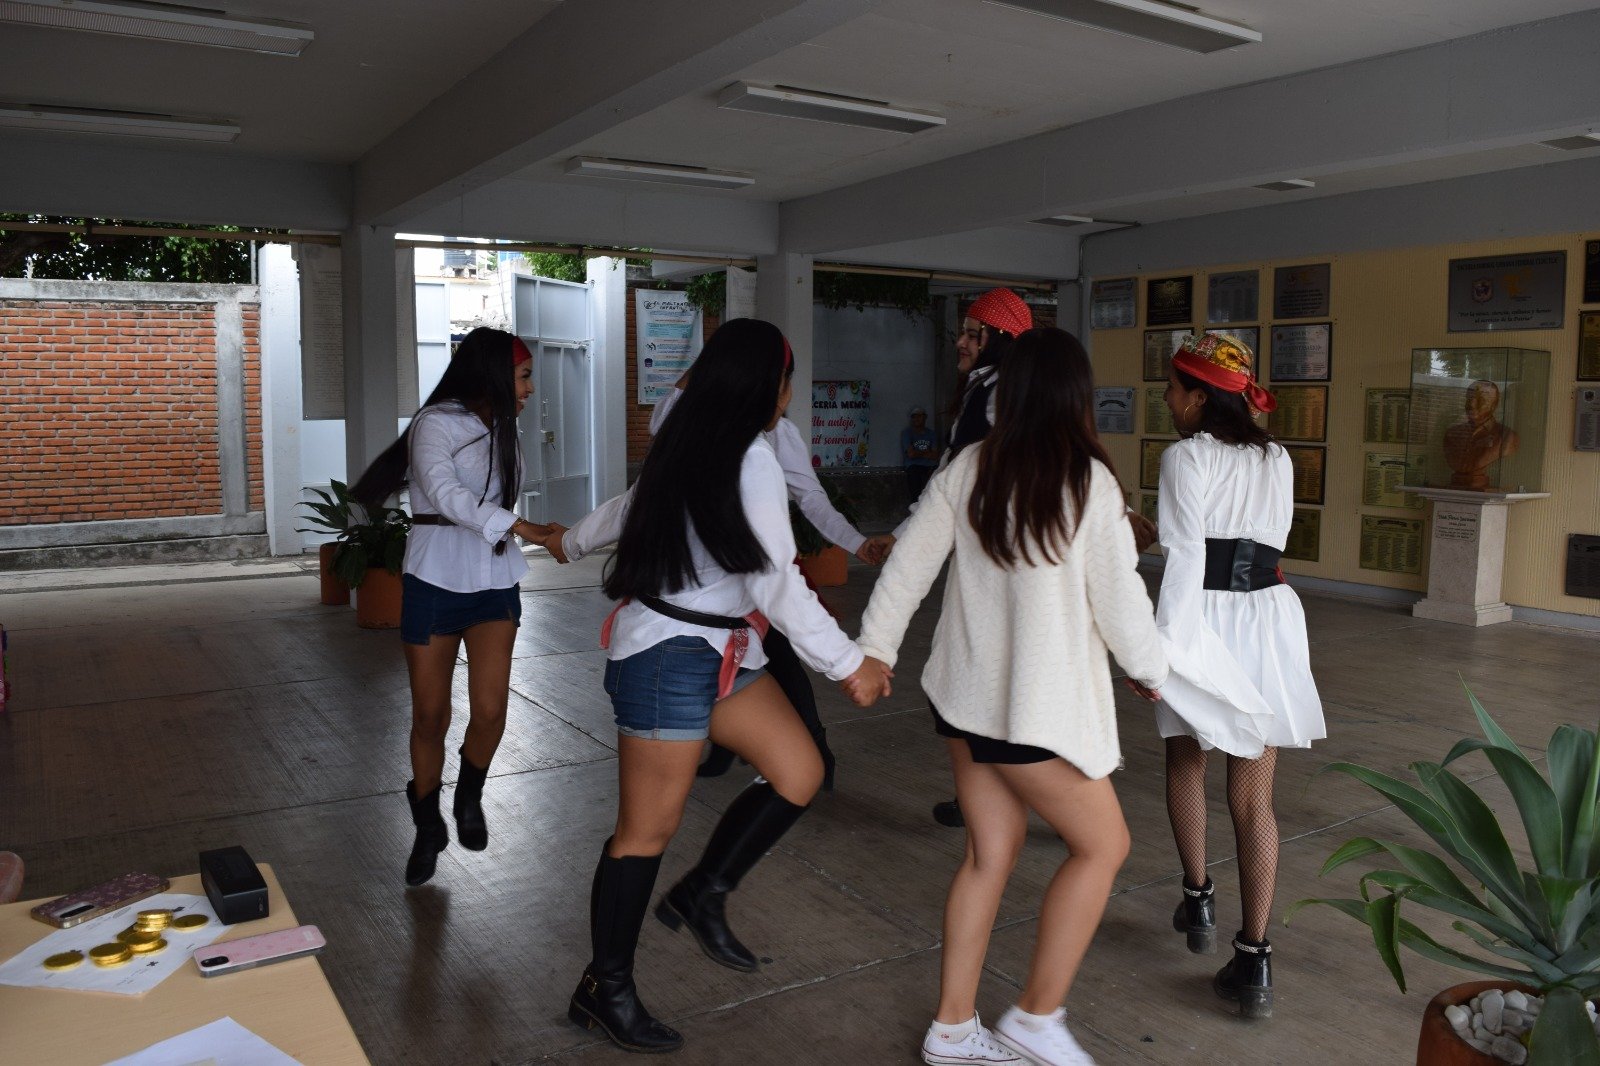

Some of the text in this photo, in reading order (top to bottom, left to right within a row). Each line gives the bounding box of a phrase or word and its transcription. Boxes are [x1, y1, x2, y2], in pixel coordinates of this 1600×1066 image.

[812, 400, 867, 409] CERIA MEMO
[828, 416, 856, 431] antojo,
[825, 434, 859, 445] sonrisas!
